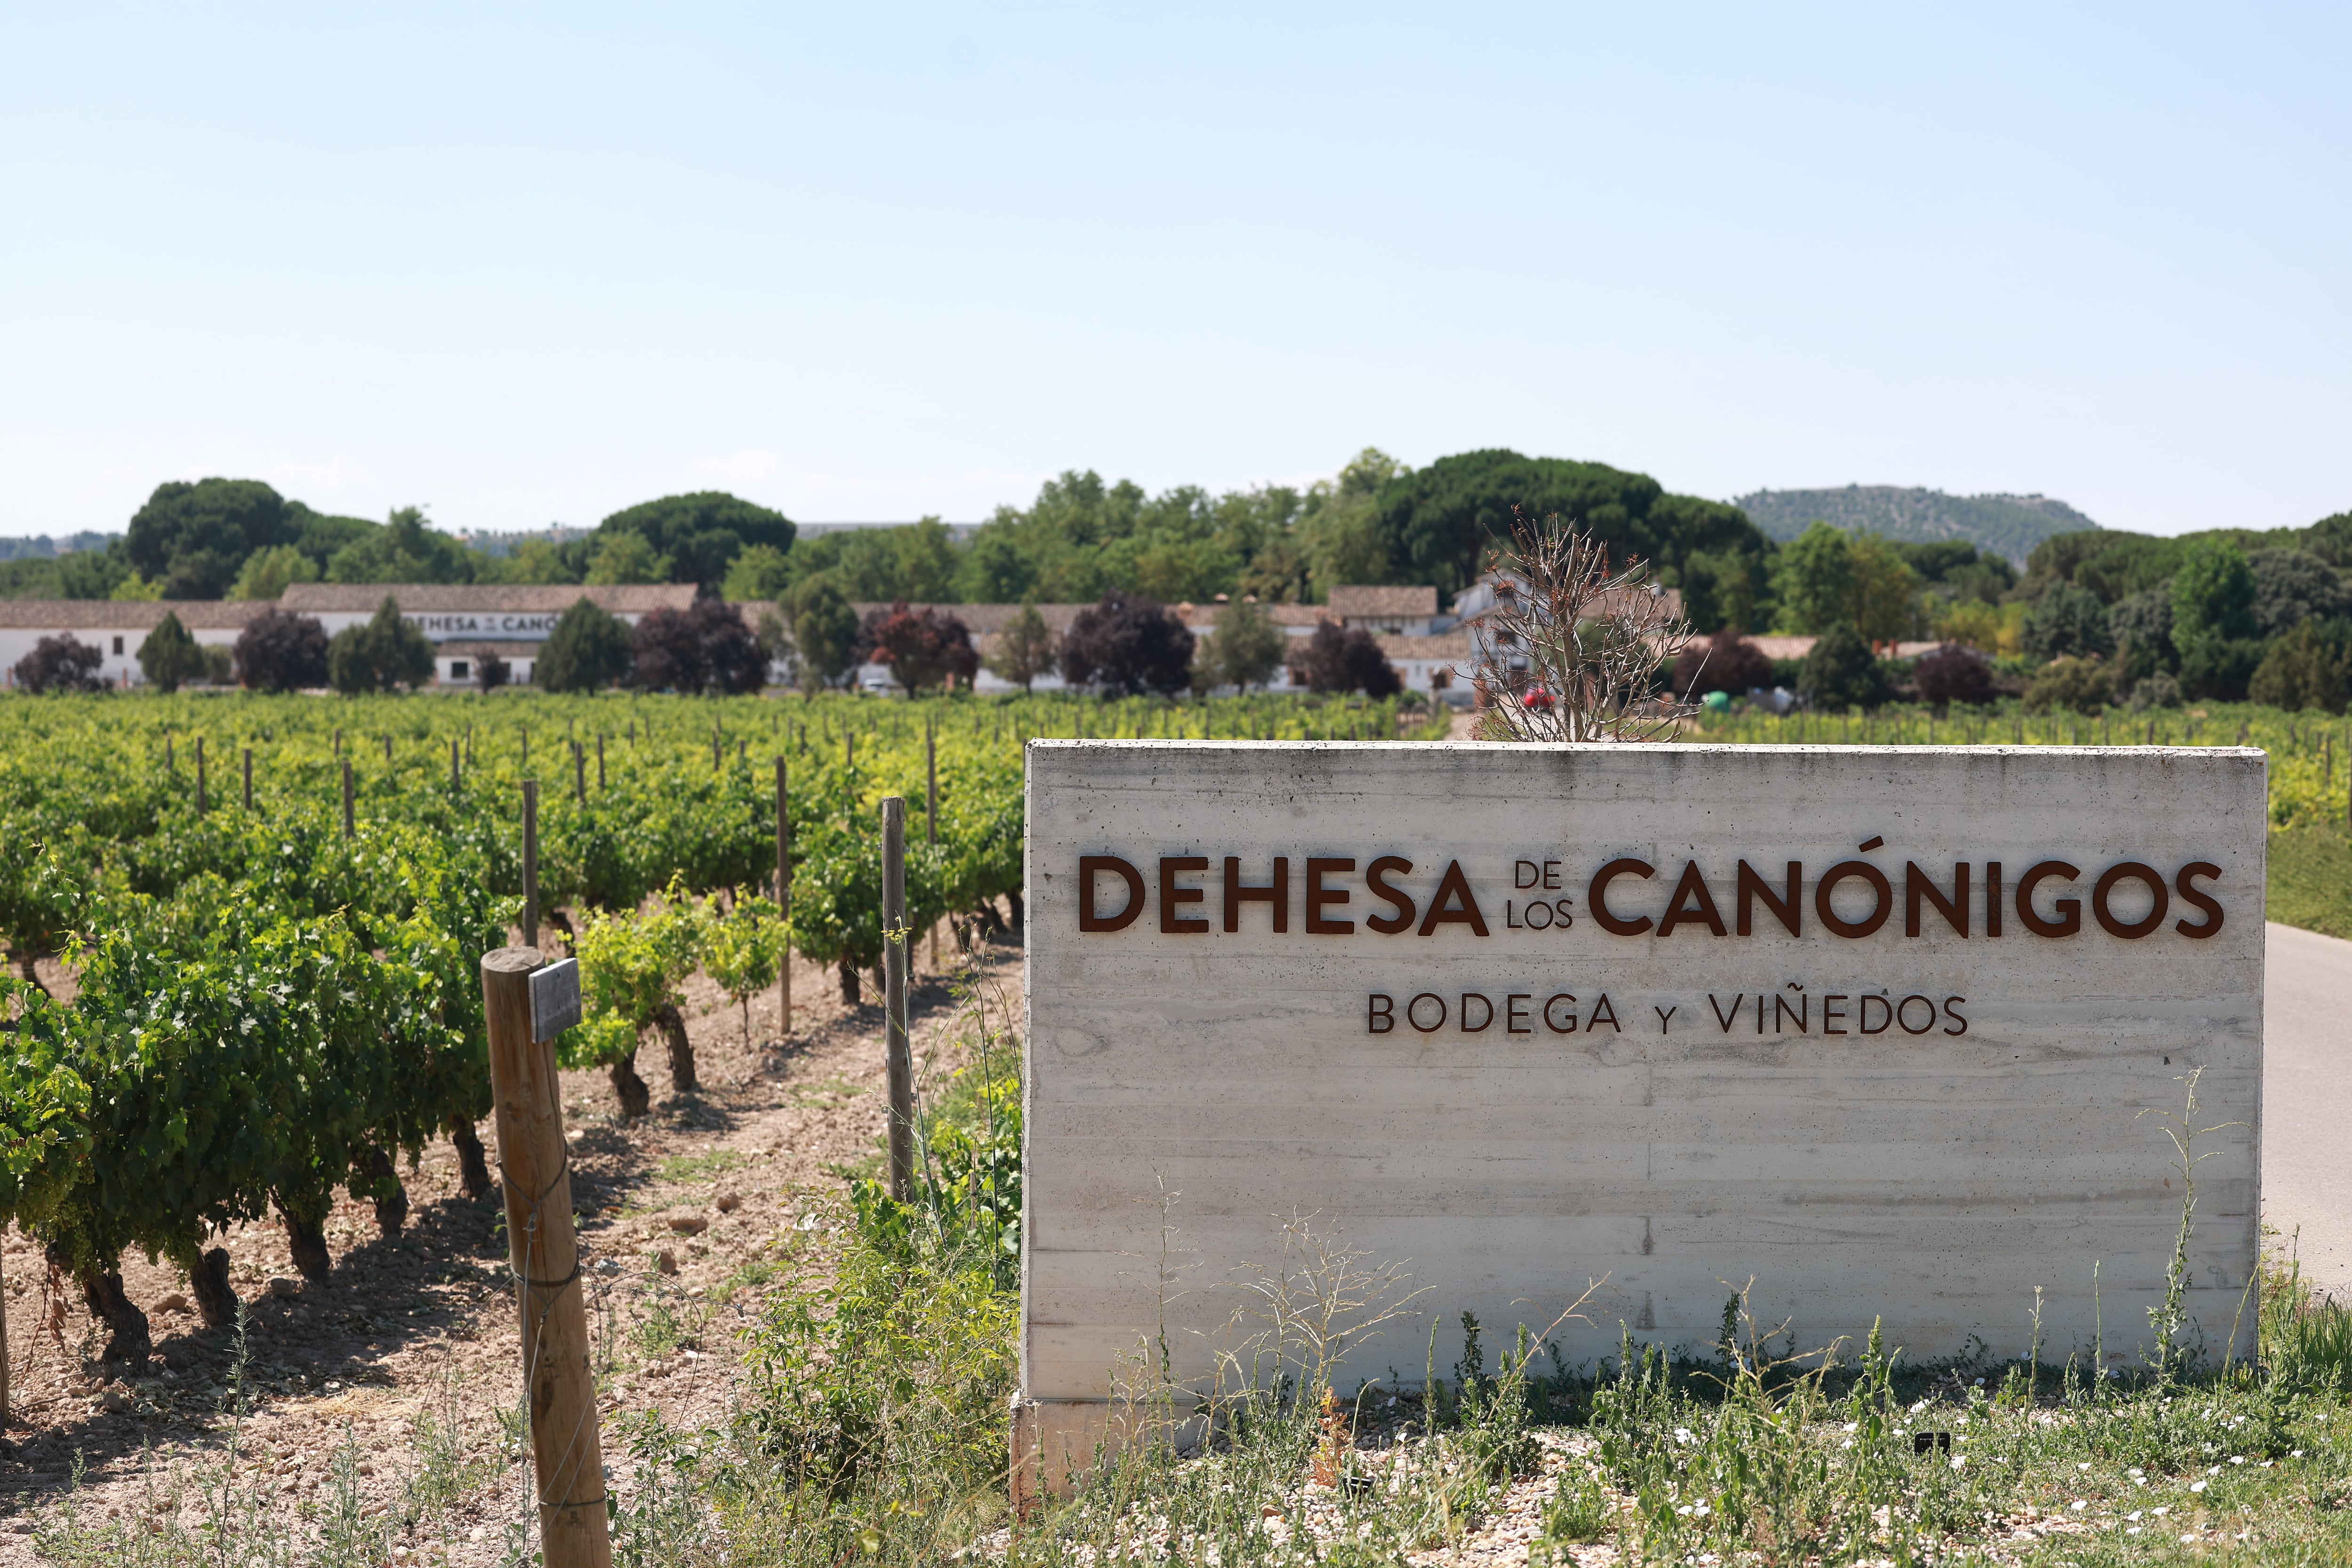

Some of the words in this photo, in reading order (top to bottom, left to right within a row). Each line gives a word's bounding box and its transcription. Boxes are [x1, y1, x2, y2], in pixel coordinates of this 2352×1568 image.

[1079, 856, 1490, 937] DEHESA
[1515, 860, 1562, 889] DE
[1588, 836, 2224, 942] CANÓNIGOS
[1507, 899, 1573, 930] LOS
[1368, 993, 1621, 1034] BODEGA
[1708, 982, 1968, 1036] VIÑEDOS
